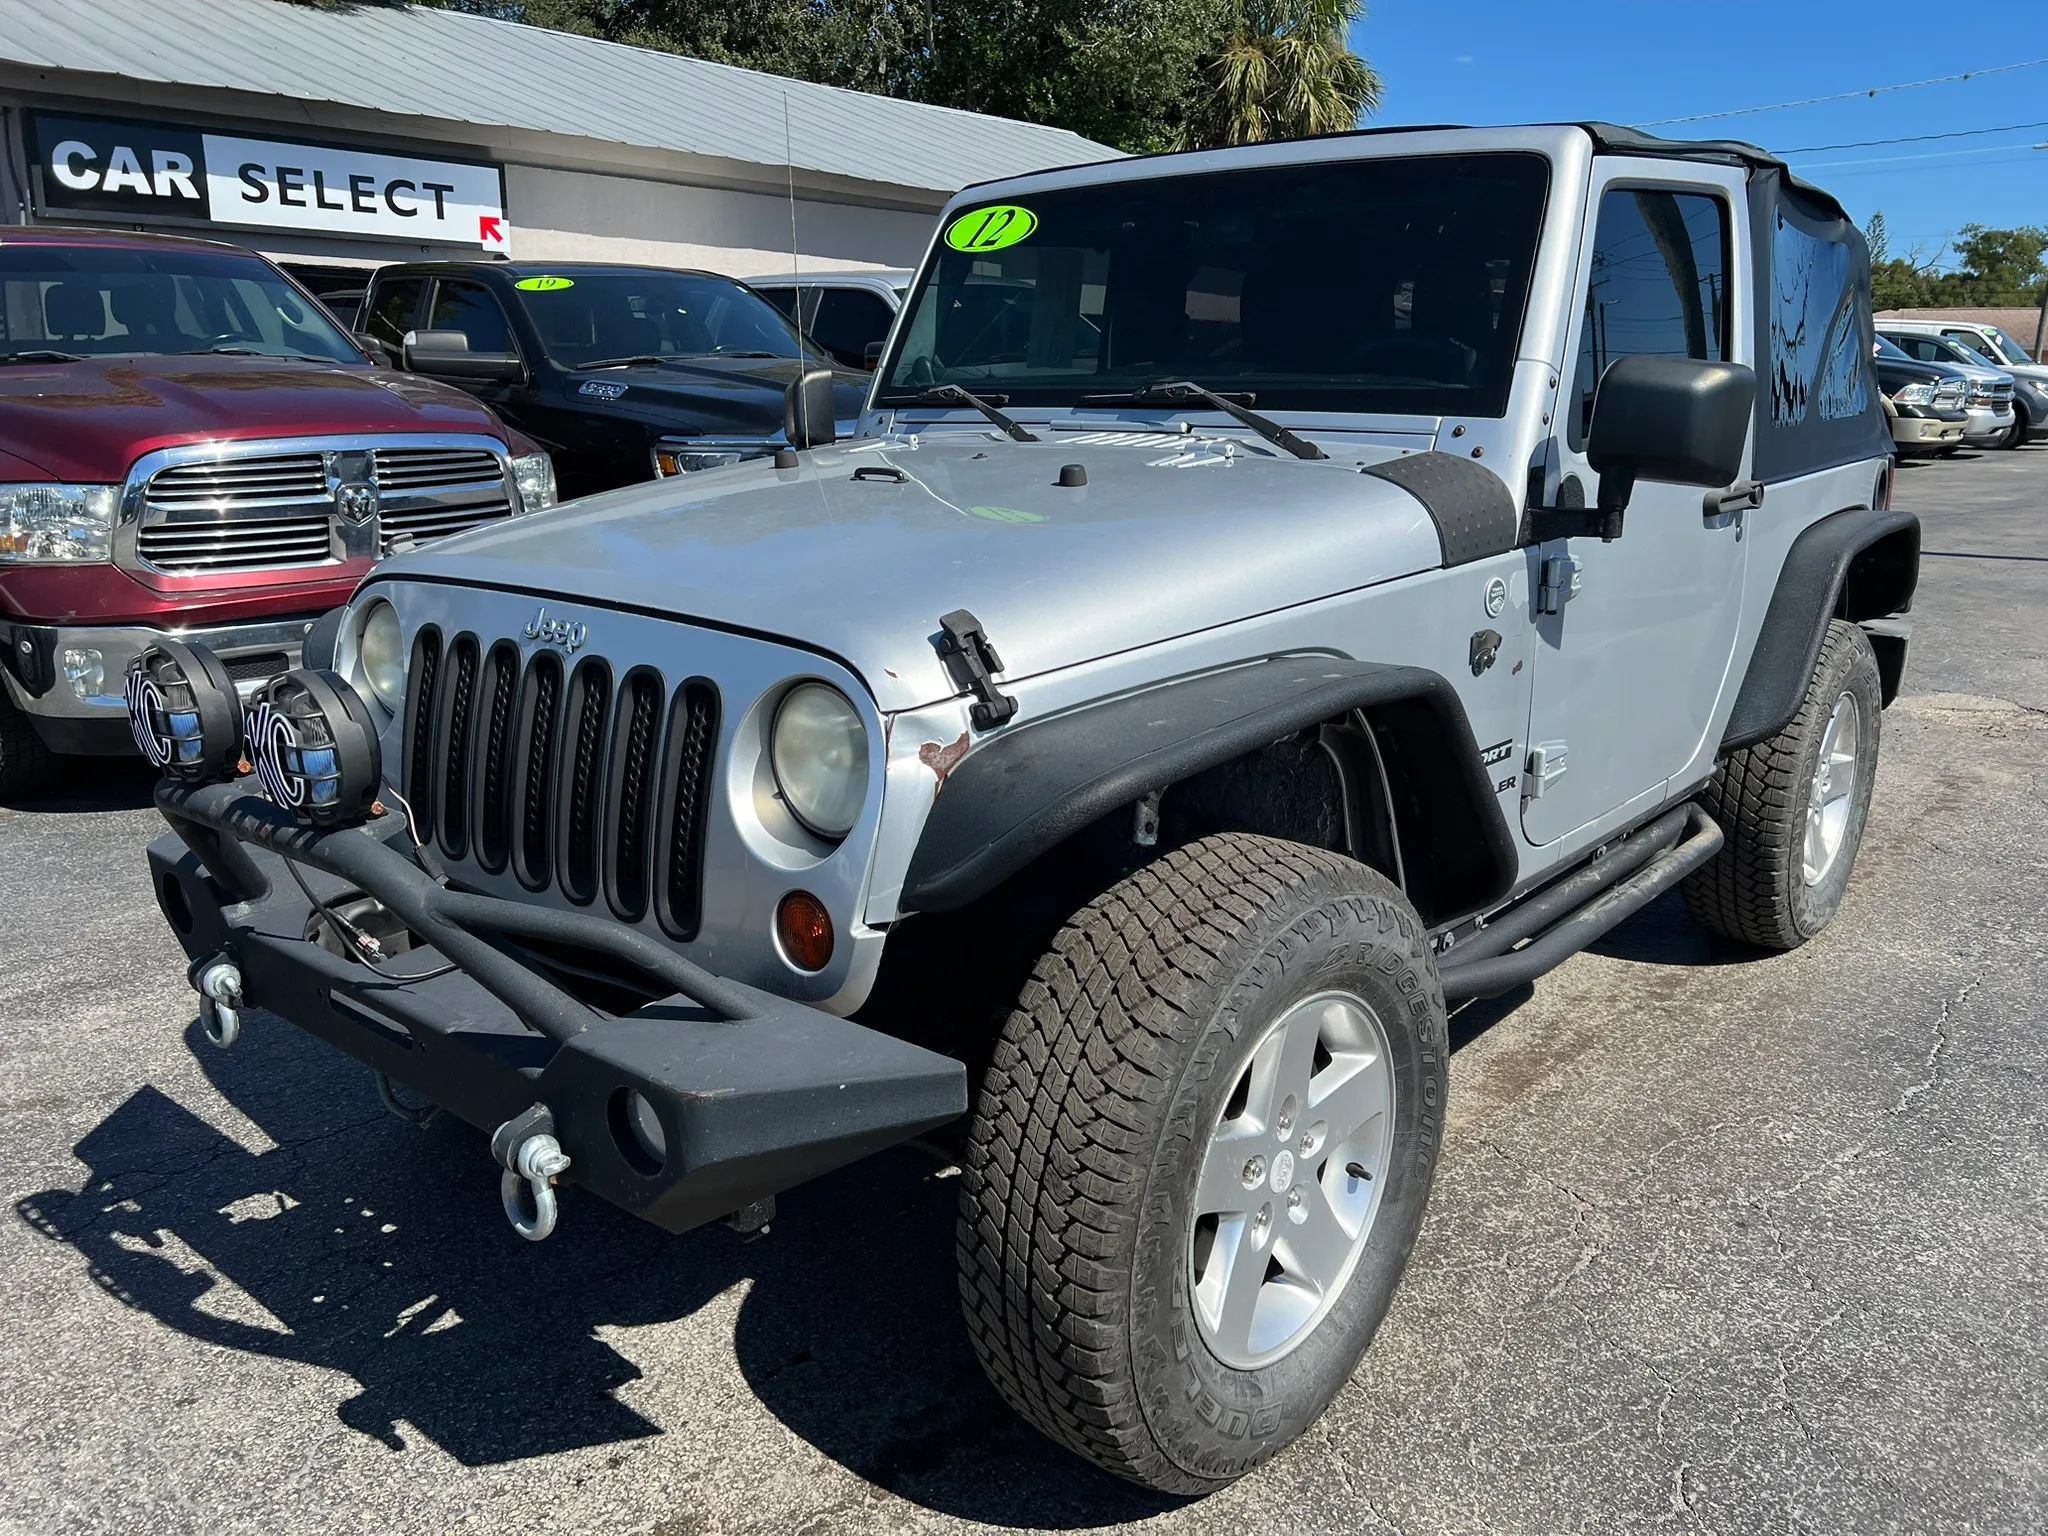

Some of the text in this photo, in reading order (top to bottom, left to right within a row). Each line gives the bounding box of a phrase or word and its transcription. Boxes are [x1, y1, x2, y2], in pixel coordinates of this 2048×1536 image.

[51, 140, 454, 220] CAR SELECT
[962, 209, 1016, 248] 12
[536, 278, 556, 289] 19
[524, 608, 587, 654] Jeep
[125, 670, 171, 767] KC
[246, 702, 304, 810] KC
[1316, 940, 1439, 1185] BRIDGESTONE
[1172, 1255, 1283, 1440] DUELER
